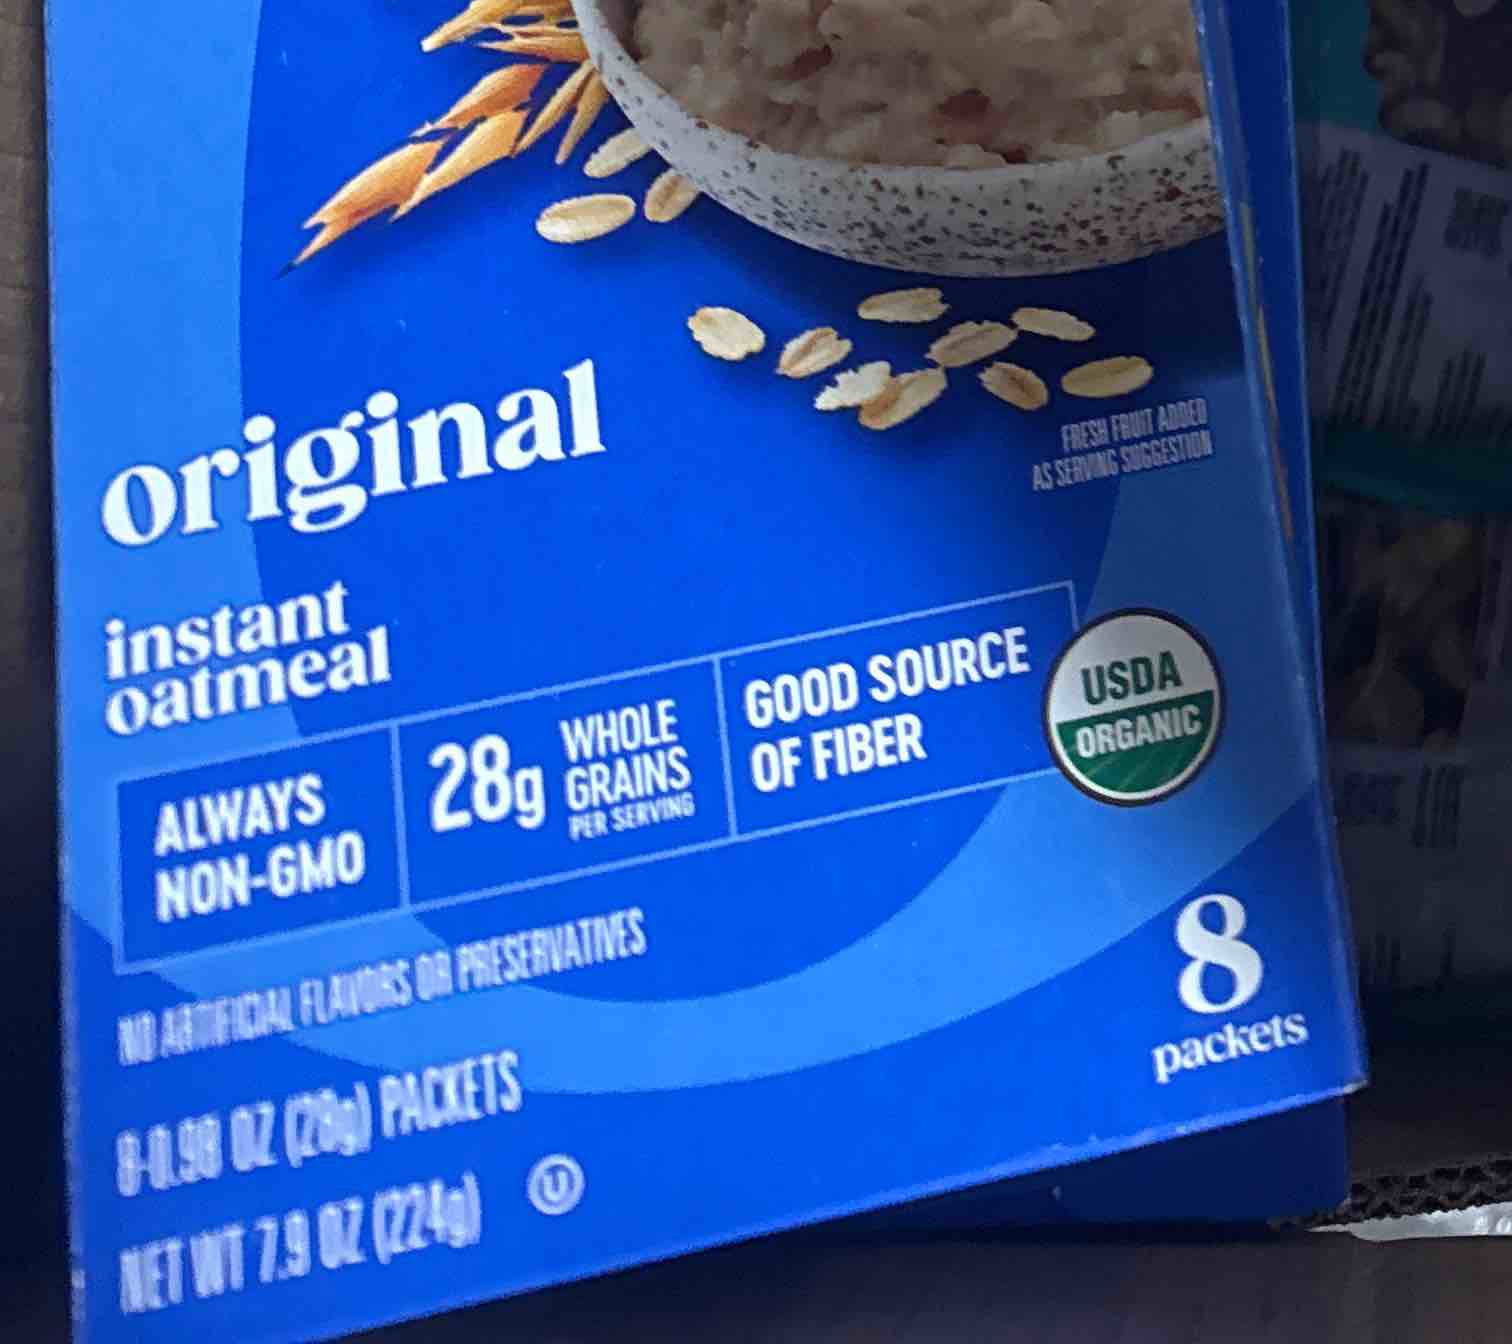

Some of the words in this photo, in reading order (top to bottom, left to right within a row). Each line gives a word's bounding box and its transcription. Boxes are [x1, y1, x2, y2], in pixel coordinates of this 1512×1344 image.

[101, 358, 606, 547] original
[1031, 463, 1053, 492] AS
[1121, 429, 1213, 477] SUGGESTION
[1060, 419, 1108, 451] FRESH
[1110, 411, 1155, 442] FRUIT
[1158, 397, 1208, 430] ADDED
[105, 580, 349, 680] instant
[105, 625, 391, 736] oatmeal
[744, 661, 859, 730] GOOD
[869, 625, 1030, 698] SOURCE
[1081, 650, 1183, 707] USDA
[559, 698, 680, 764] WHOLE
[751, 735, 802, 794] OF
[811, 713, 927, 782] FIBER
[1074, 702, 1202, 761] ORGANIC
[154, 772, 326, 857] ALWAYS
[427, 733, 546, 834] 28g
[564, 745, 692, 812] GRAINS
[569, 811, 609, 841] PER
[612, 793, 695, 835] SERVING
[155, 830, 367, 923] NON-GMO
[117, 1010, 158, 1066] NO
[299, 957, 412, 1026] FLAVORS
[414, 948, 453, 1001] OR
[456, 905, 648, 993] PRESERVATIVES
[1175, 893, 1265, 1014] 8
[1151, 1012, 1310, 1084] packets
[379, 1049, 522, 1140] PACKETS
[119, 1236, 185, 1315] NET
[190, 1222, 246, 1300] WT
[257, 1209, 311, 1283] 7.9
[317, 1195, 367, 1270] OZ
[372, 1170, 483, 1266] (224g)
